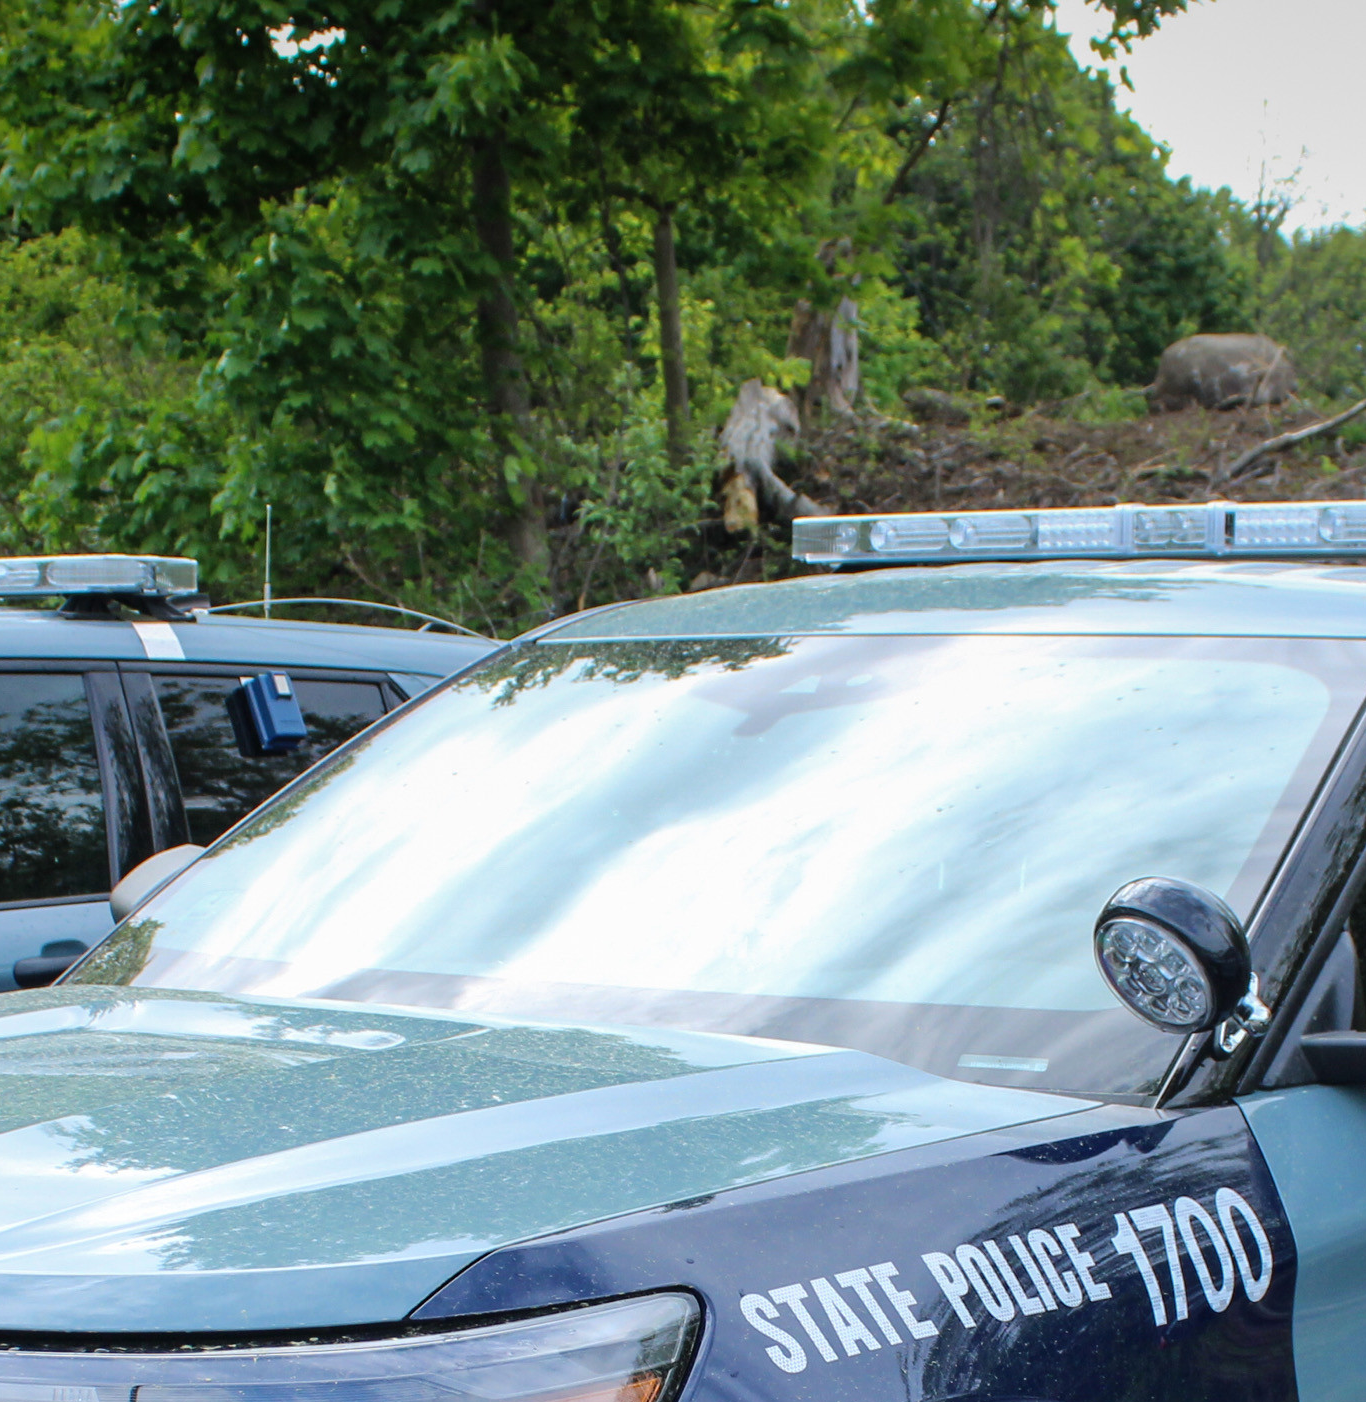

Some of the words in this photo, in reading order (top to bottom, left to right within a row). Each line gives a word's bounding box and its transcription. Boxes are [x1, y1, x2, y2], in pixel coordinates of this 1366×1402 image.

[739, 1261, 939, 1375] STATE
[921, 1221, 1114, 1330] POLICE
[1110, 1186, 1274, 1327] 1700
